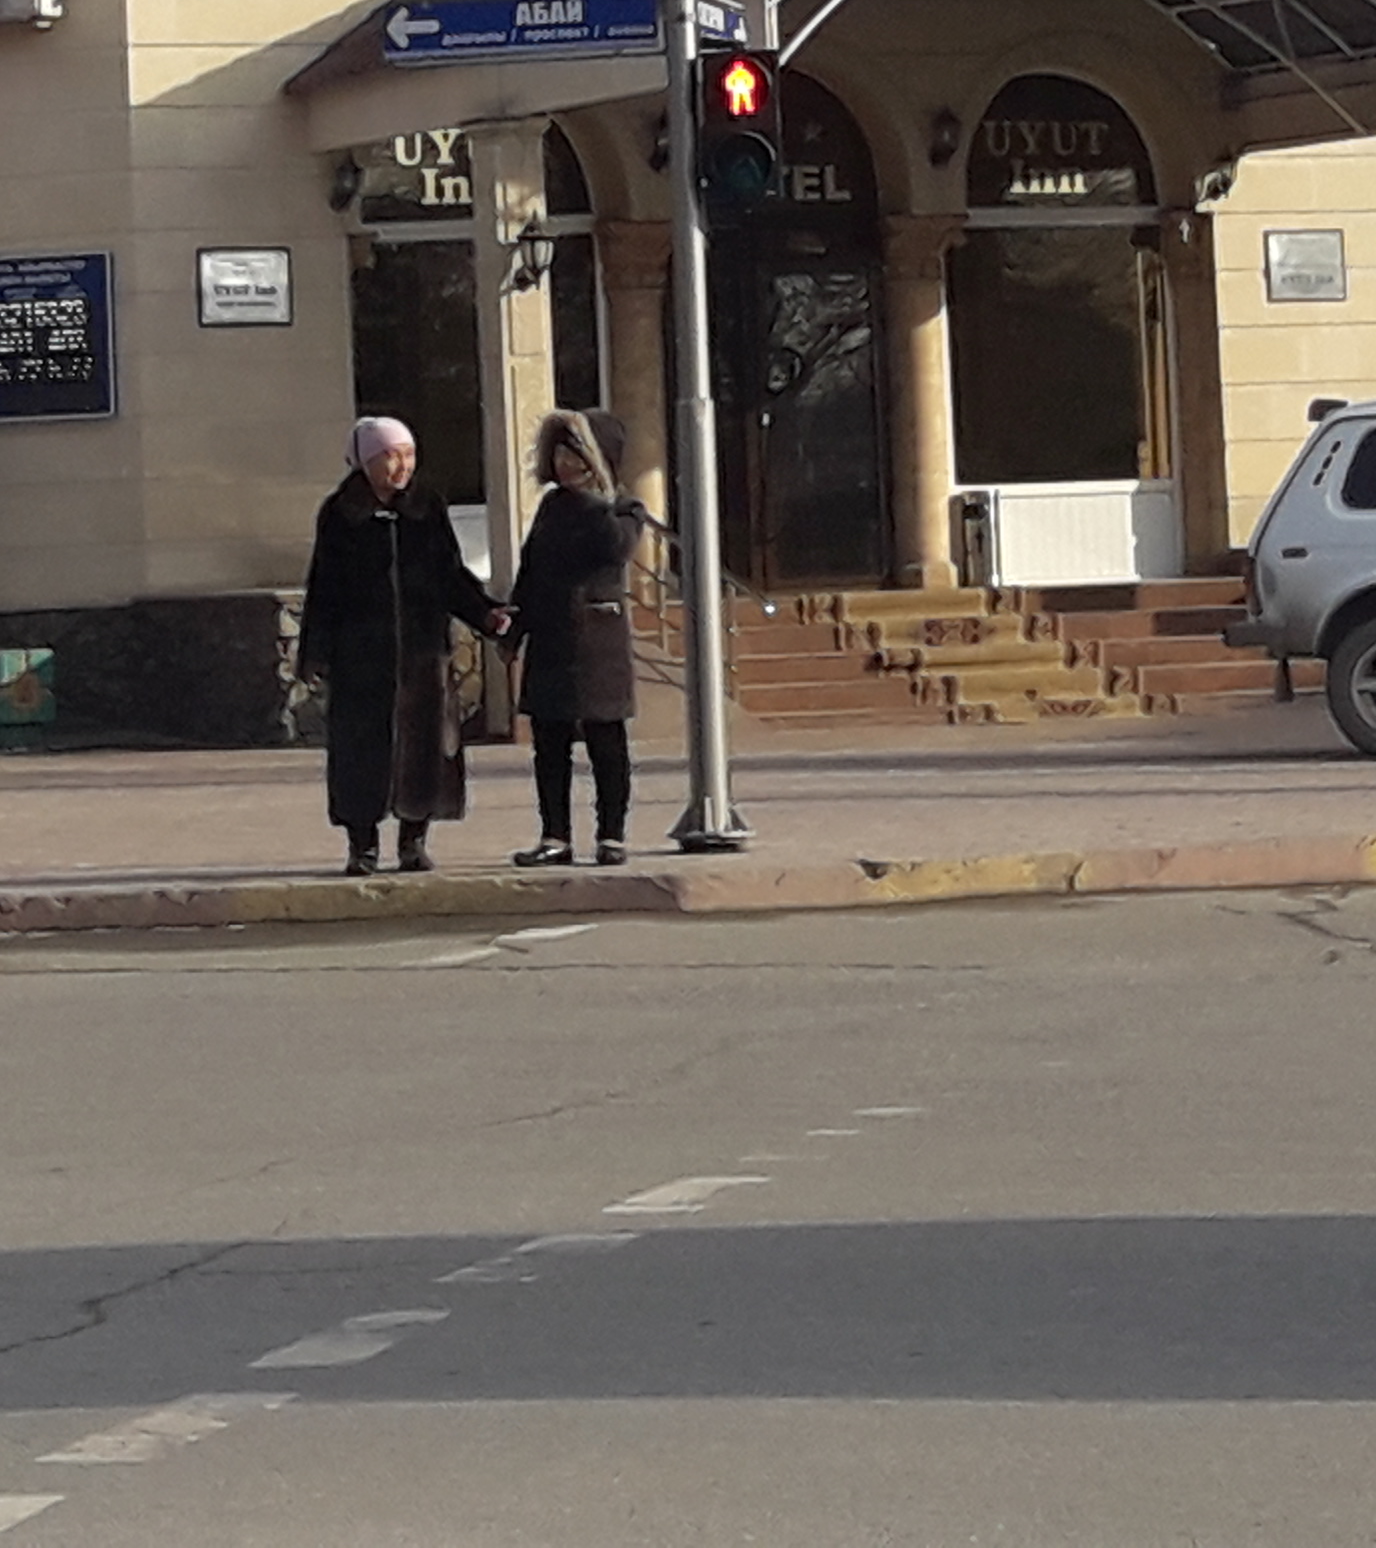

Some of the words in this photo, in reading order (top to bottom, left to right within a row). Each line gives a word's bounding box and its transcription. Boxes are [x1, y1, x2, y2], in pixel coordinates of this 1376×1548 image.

[394, 127, 466, 166] UY
[982, 119, 1110, 157] UYUT
[420, 167, 473, 206] In
